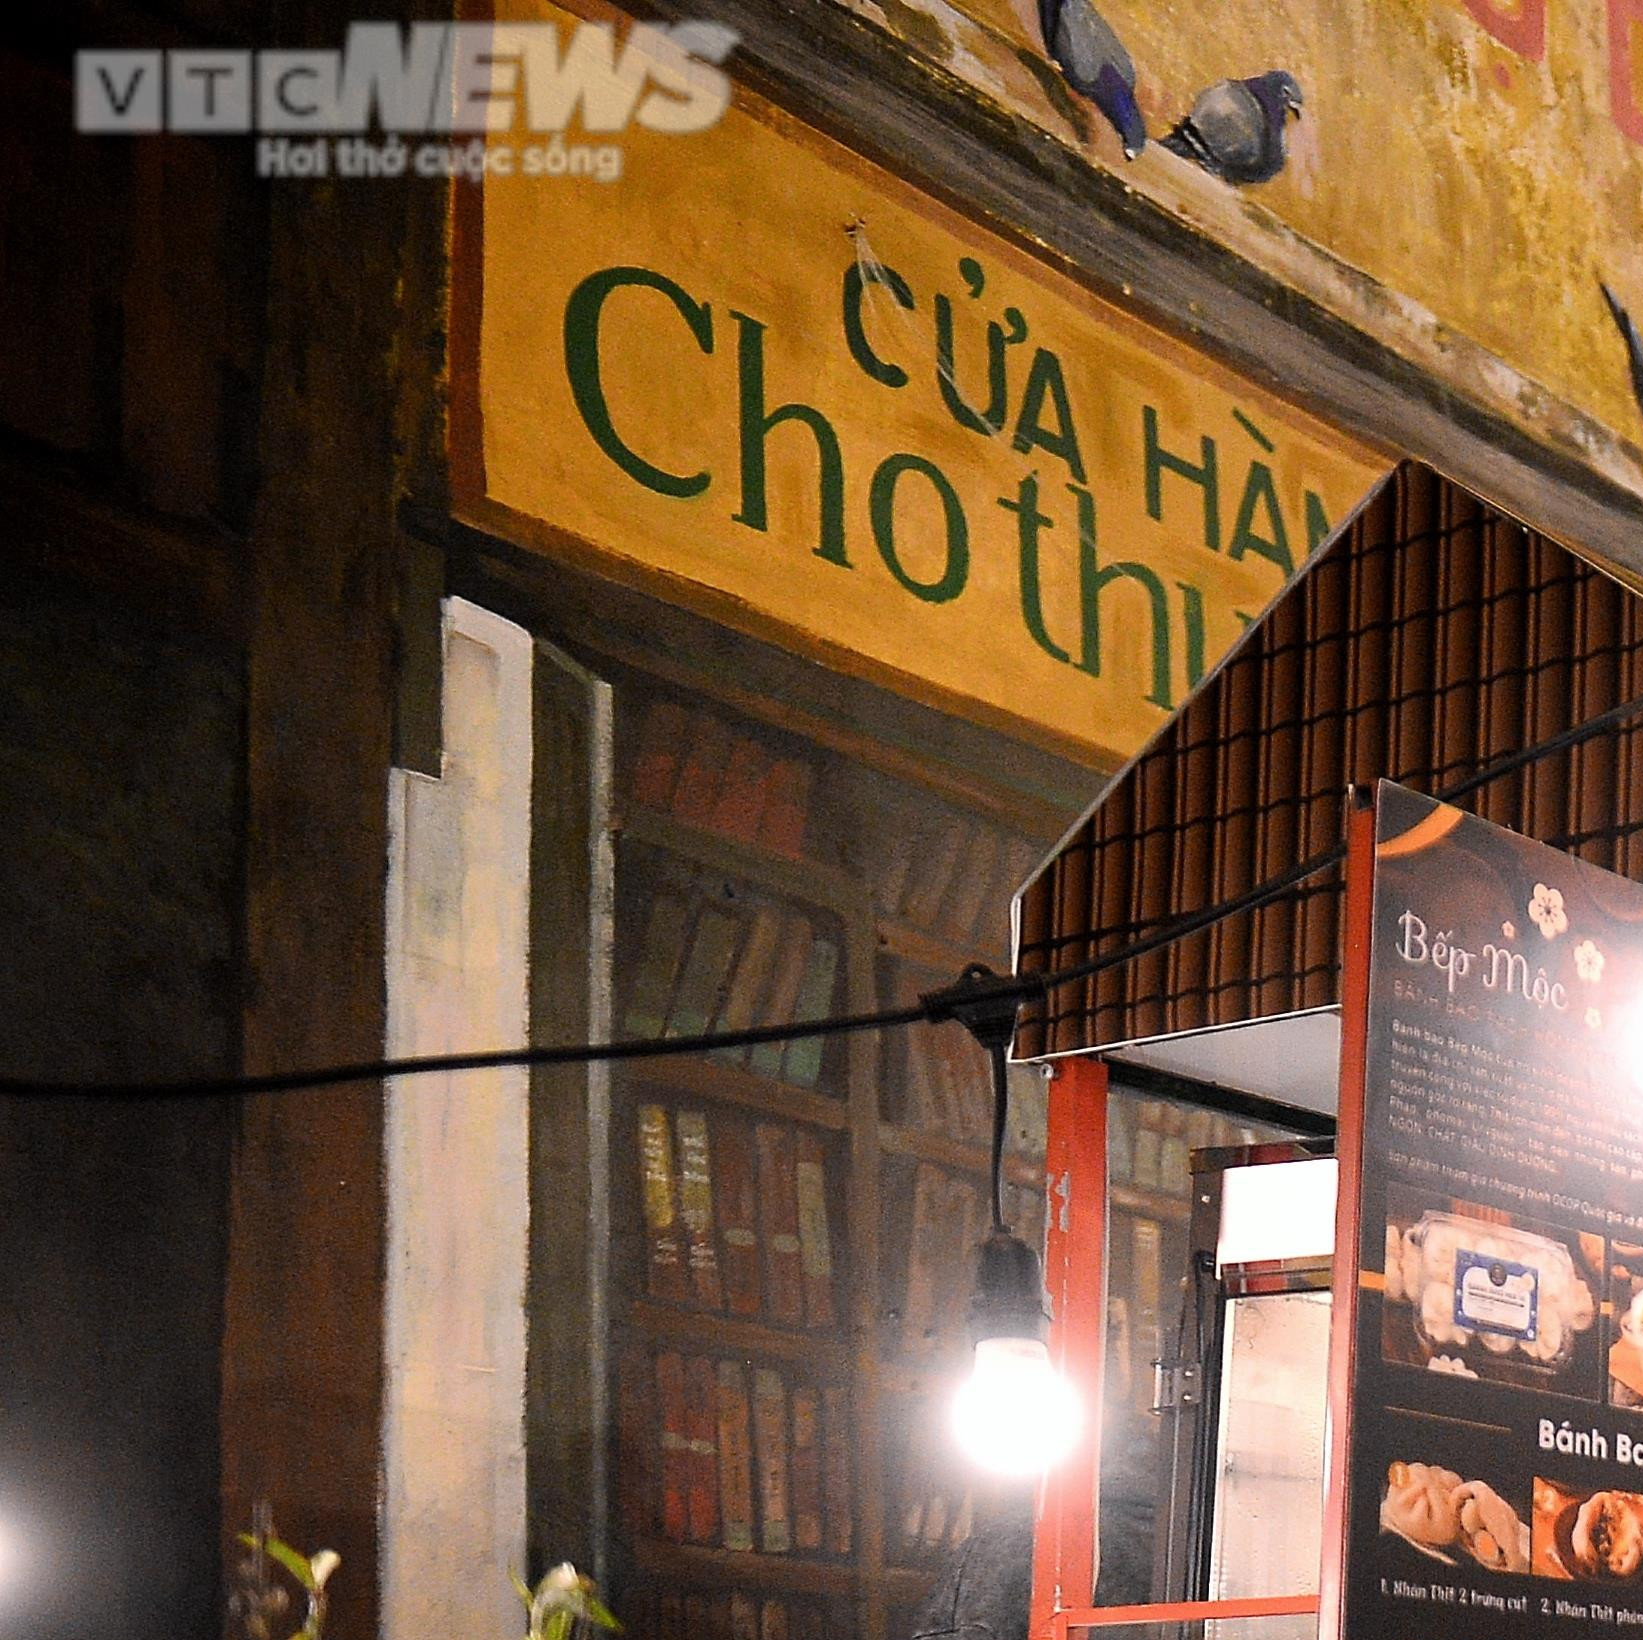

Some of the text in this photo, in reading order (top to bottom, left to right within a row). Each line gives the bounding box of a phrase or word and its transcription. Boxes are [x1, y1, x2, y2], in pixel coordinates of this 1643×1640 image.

[842, 257, 1087, 485] CỬA
[563, 266, 970, 604] Cho
[1395, 910, 1568, 1010] Bếp Mộc
[1538, 1416, 1609, 1460] Bánh
[1458, 1587, 1468, 1604] 2
